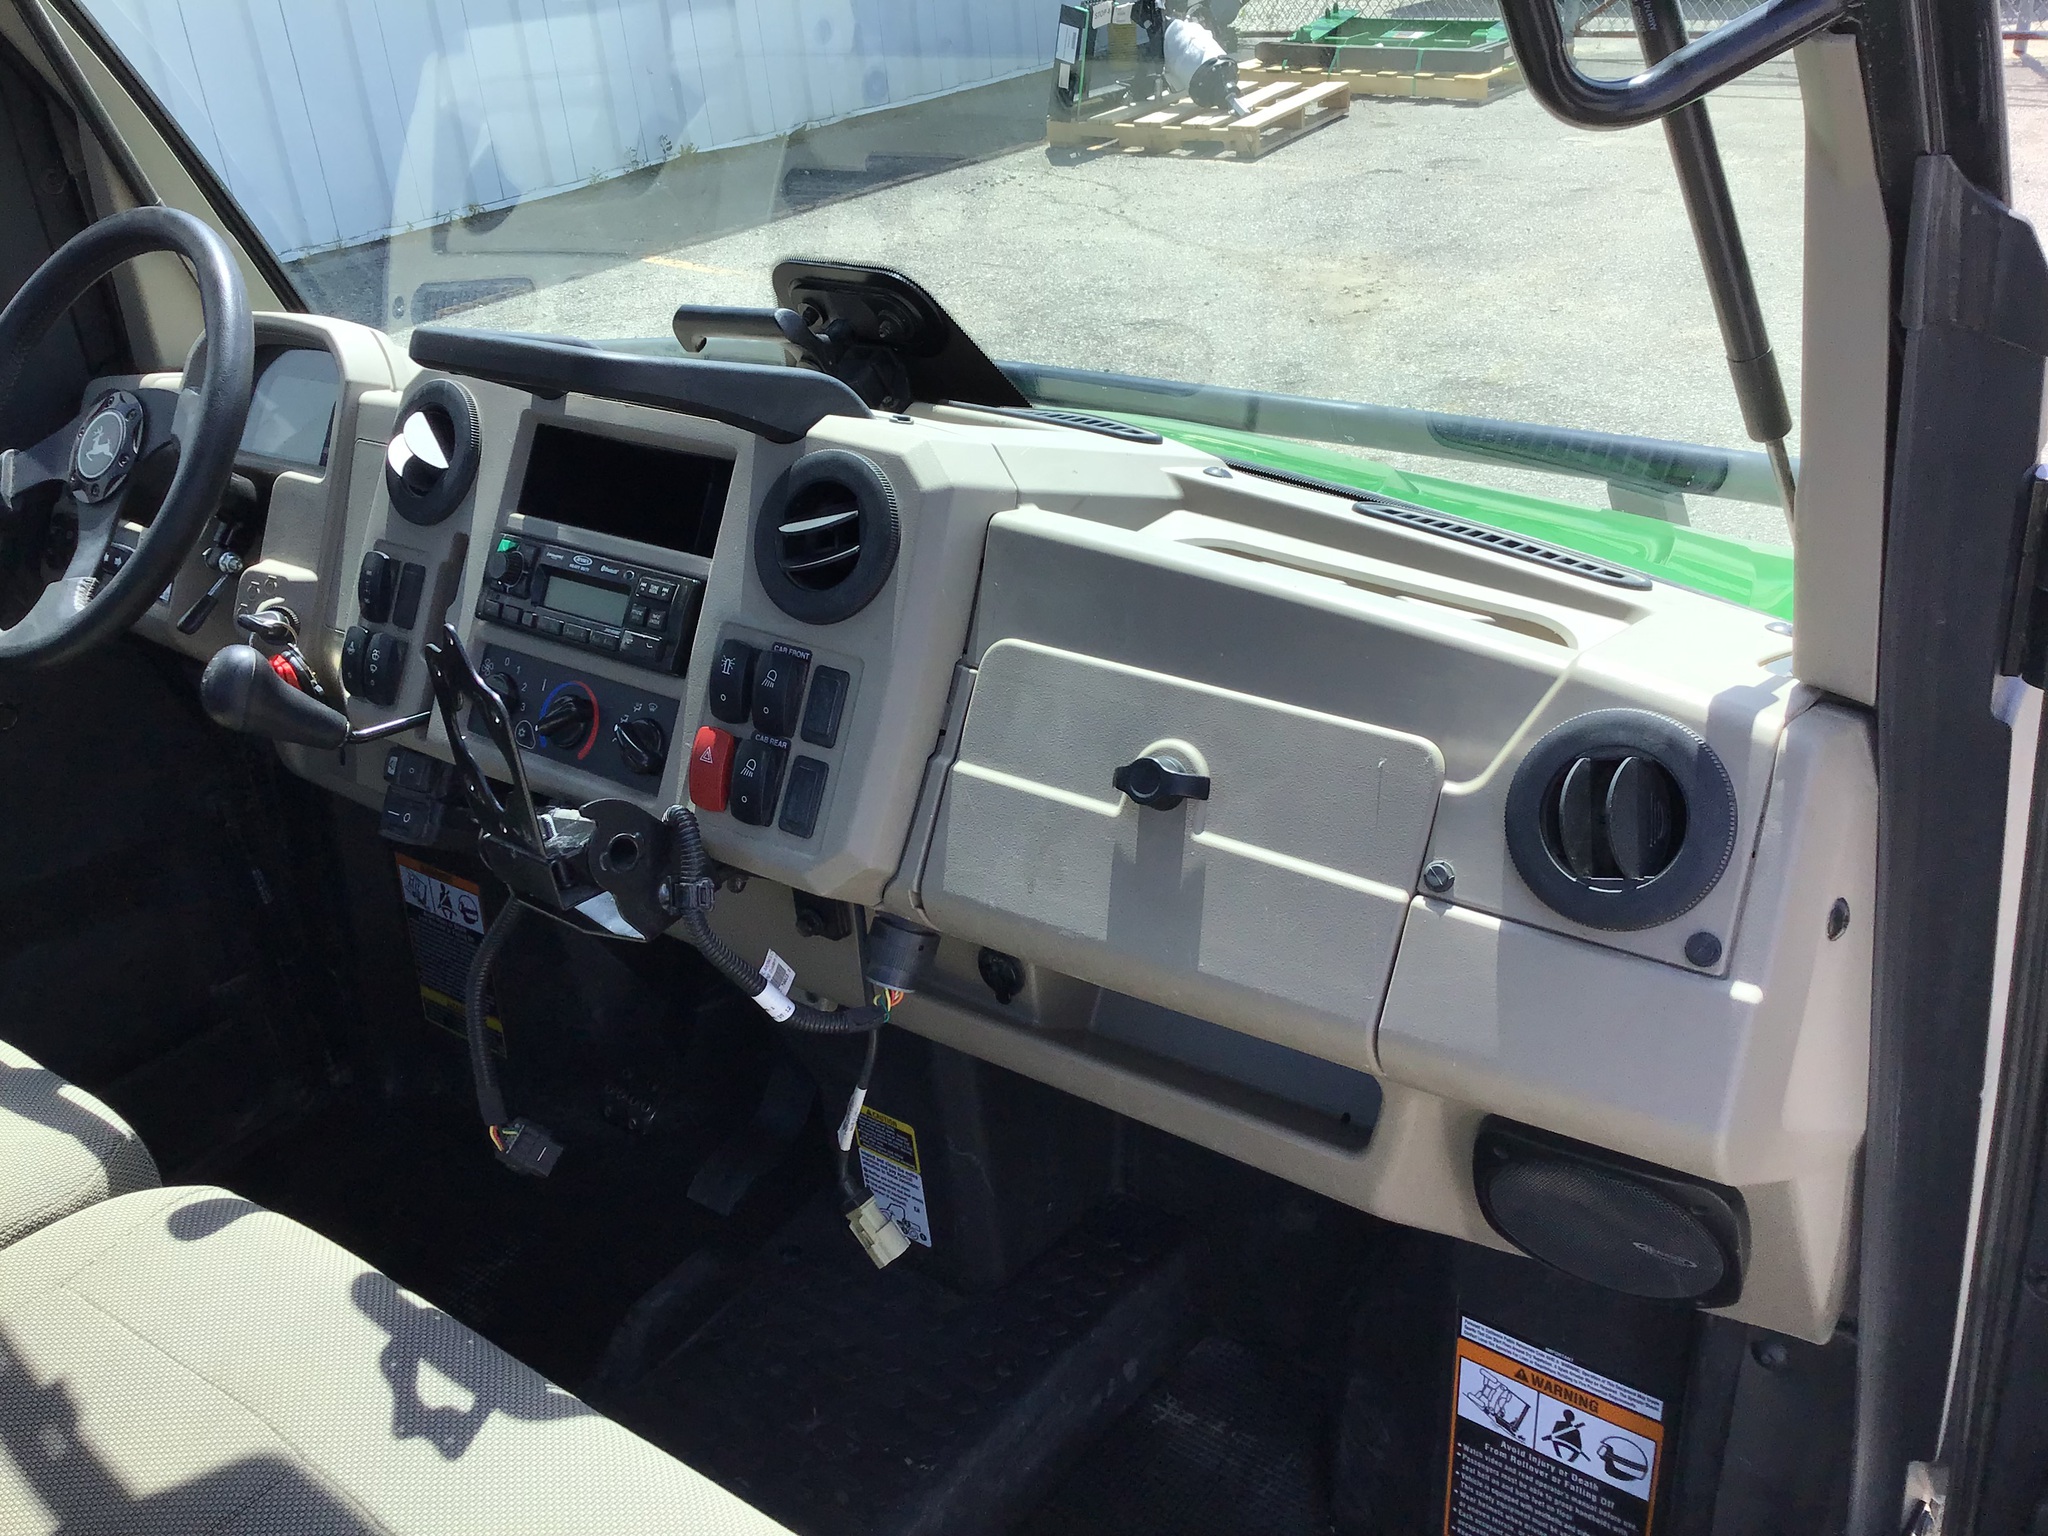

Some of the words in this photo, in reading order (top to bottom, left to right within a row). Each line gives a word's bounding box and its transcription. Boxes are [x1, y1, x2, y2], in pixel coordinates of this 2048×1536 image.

[788, 648, 810, 660] FRONT
[521, 683, 527, 692] 2
[520, 702, 526, 711] 3
[755, 734, 769, 744] CAB
[770, 737, 788, 749] REAR
[1530, 1372, 1599, 1414] WARNING
[1484, 1442, 1507, 1460] From
[1510, 1454, 1548, 1479] Rollover
[1551, 1474, 1561, 1485] or
[1564, 1479, 1596, 1503] Falling
[1600, 1496, 1614, 1509] Off
[1500, 1439, 1525, 1458] Avoid
[1528, 1453, 1555, 1473] Injury
[1558, 1468, 1567, 1478] or
[1570, 1472, 1598, 1492] Death
[1460, 1472, 1483, 1488] Vehicle
[1460, 1480, 1473, 1492] This
[1475, 1488, 1494, 1504] safety
[1461, 1462, 1475, 1475] seat
[1501, 1481, 1513, 1493] and
[1515, 1488, 1530, 1501] both
[1531, 1496, 1544, 1508] feet
[1462, 1452, 1499, 1477] Passengers
[1501, 1471, 1517, 1485] must
[1519, 1480, 1527, 1489] be
[1529, 1485, 1543, 1497] able
[1545, 1492, 1552, 1501] to
[1553, 1497, 1573, 1513] grasp
[1462, 1443, 1482, 1459] Watch
[1484, 1454, 1502, 1468] video
[1504, 1463, 1516, 1475] and
[1518, 1470, 1533, 1483] read
[1534, 1477, 1569, 1501] operator's
[1571, 1495, 1596, 1513] manual
[1599, 1508, 1620, 1524] before
[1459, 1490, 1476, 1504] Wear
